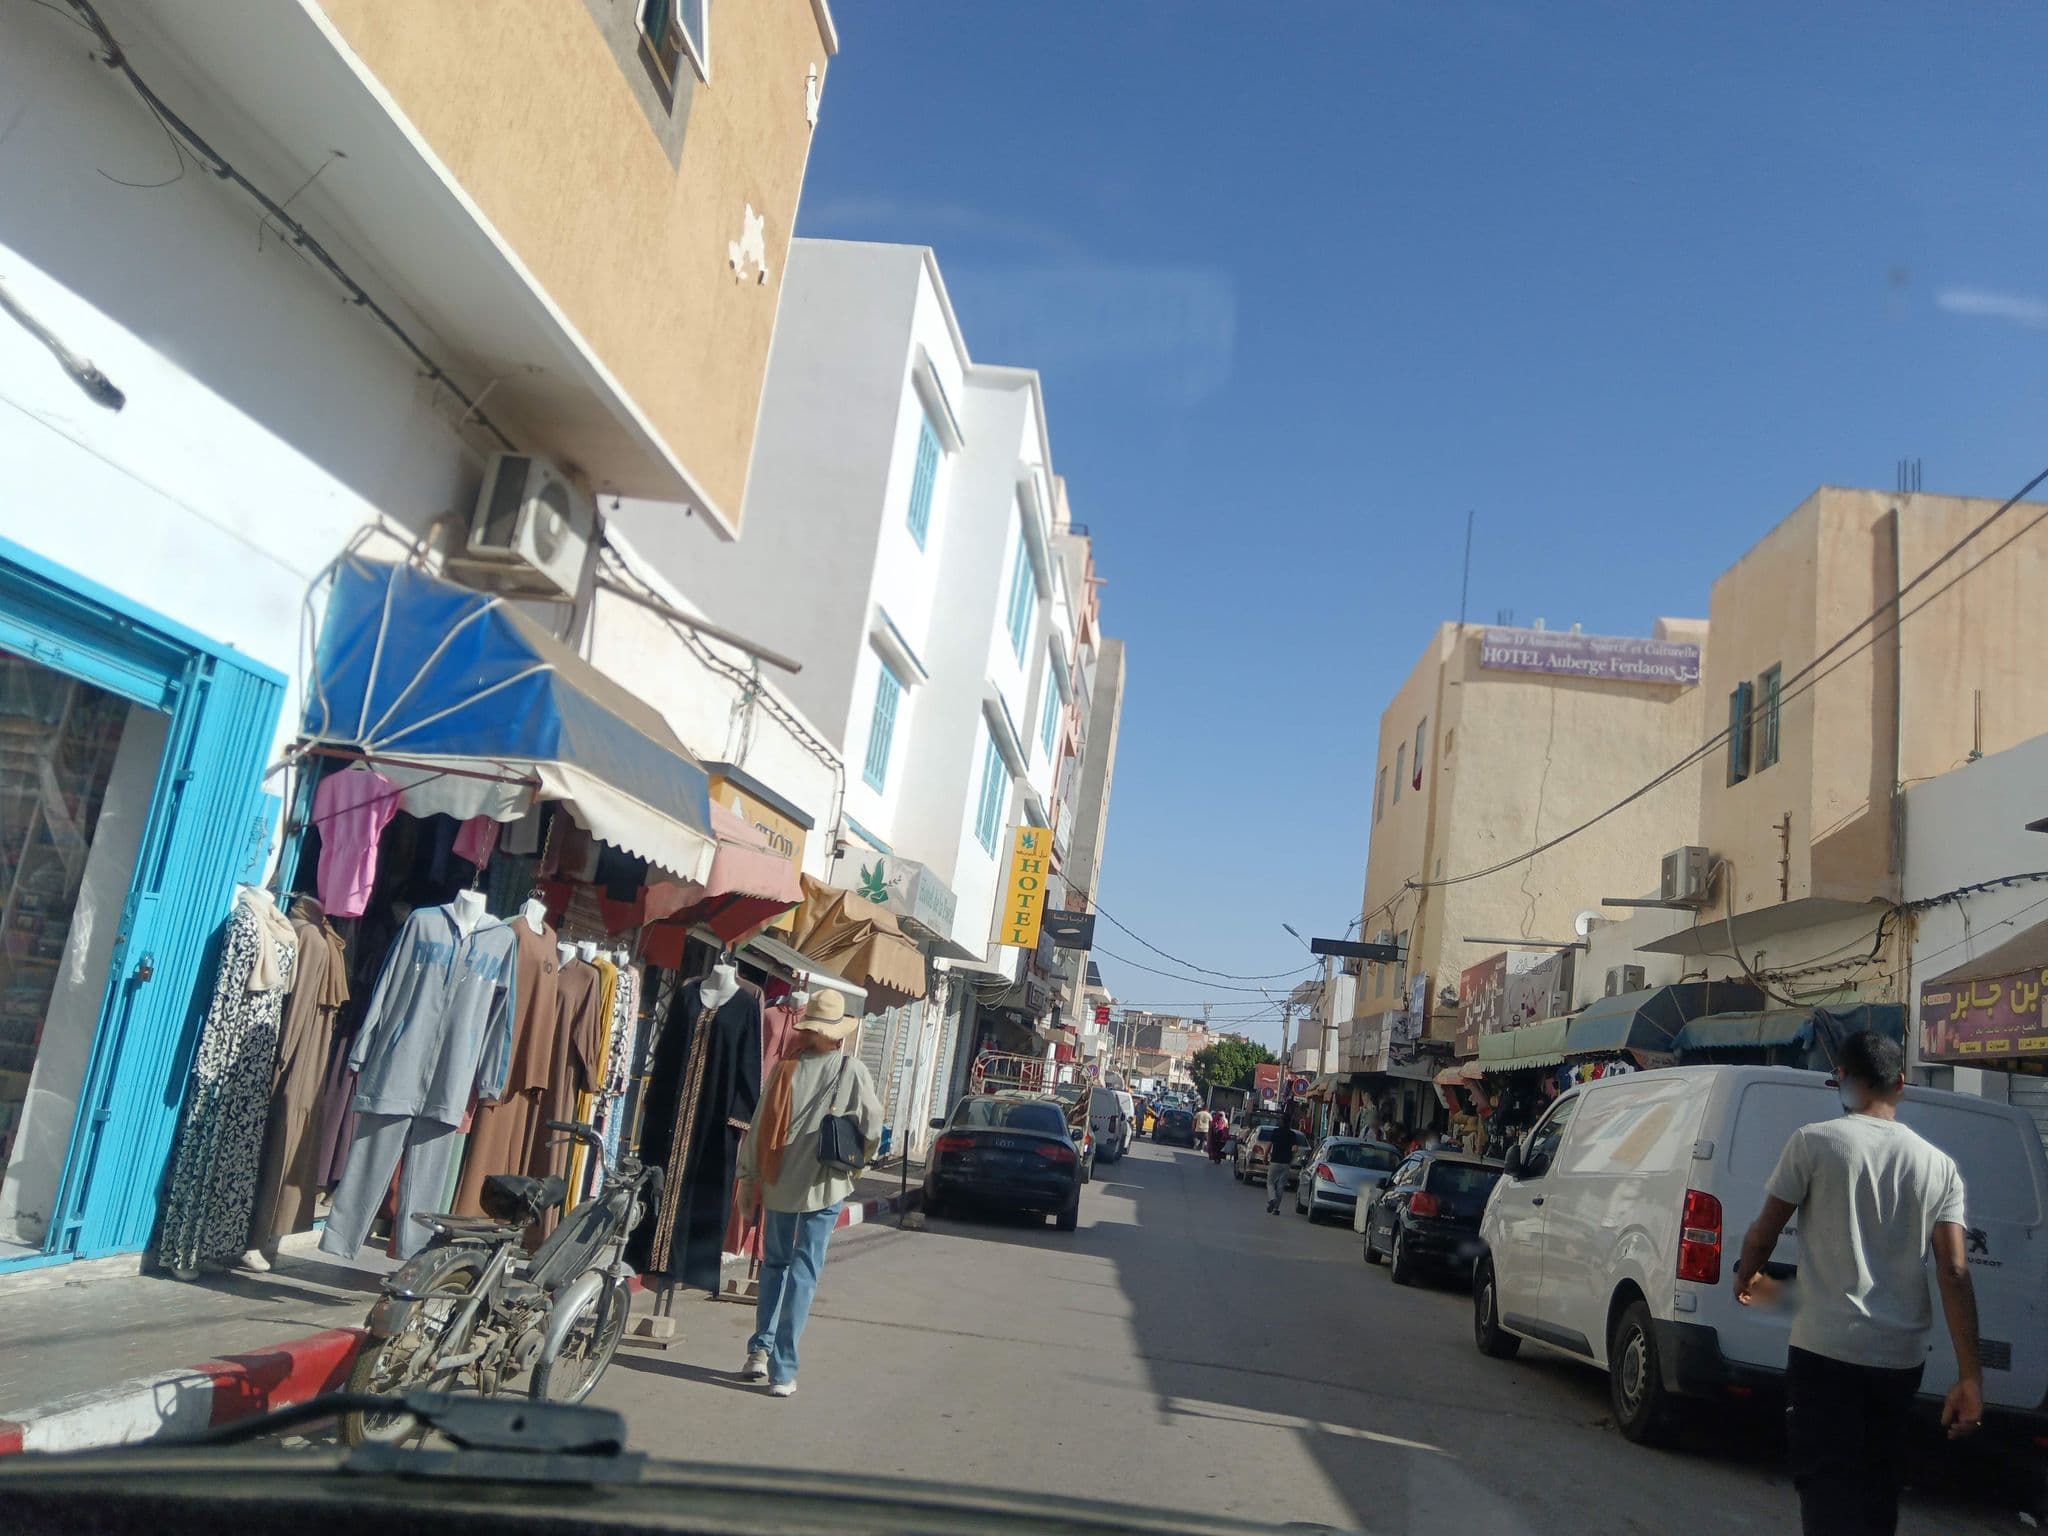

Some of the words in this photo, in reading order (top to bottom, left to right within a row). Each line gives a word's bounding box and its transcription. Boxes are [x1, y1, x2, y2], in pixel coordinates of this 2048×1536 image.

[1484, 647, 1544, 667] HOTEL
[1545, 653, 1607, 676] Auberge
[1610, 657, 1674, 677] Ferdaous
[1645, 643, 1698, 658] Culturelle
[1011, 858, 1041, 945] HOTEL
[1950, 981, 2001, 1020] جابر
[2010, 981, 2039, 1014] بن
